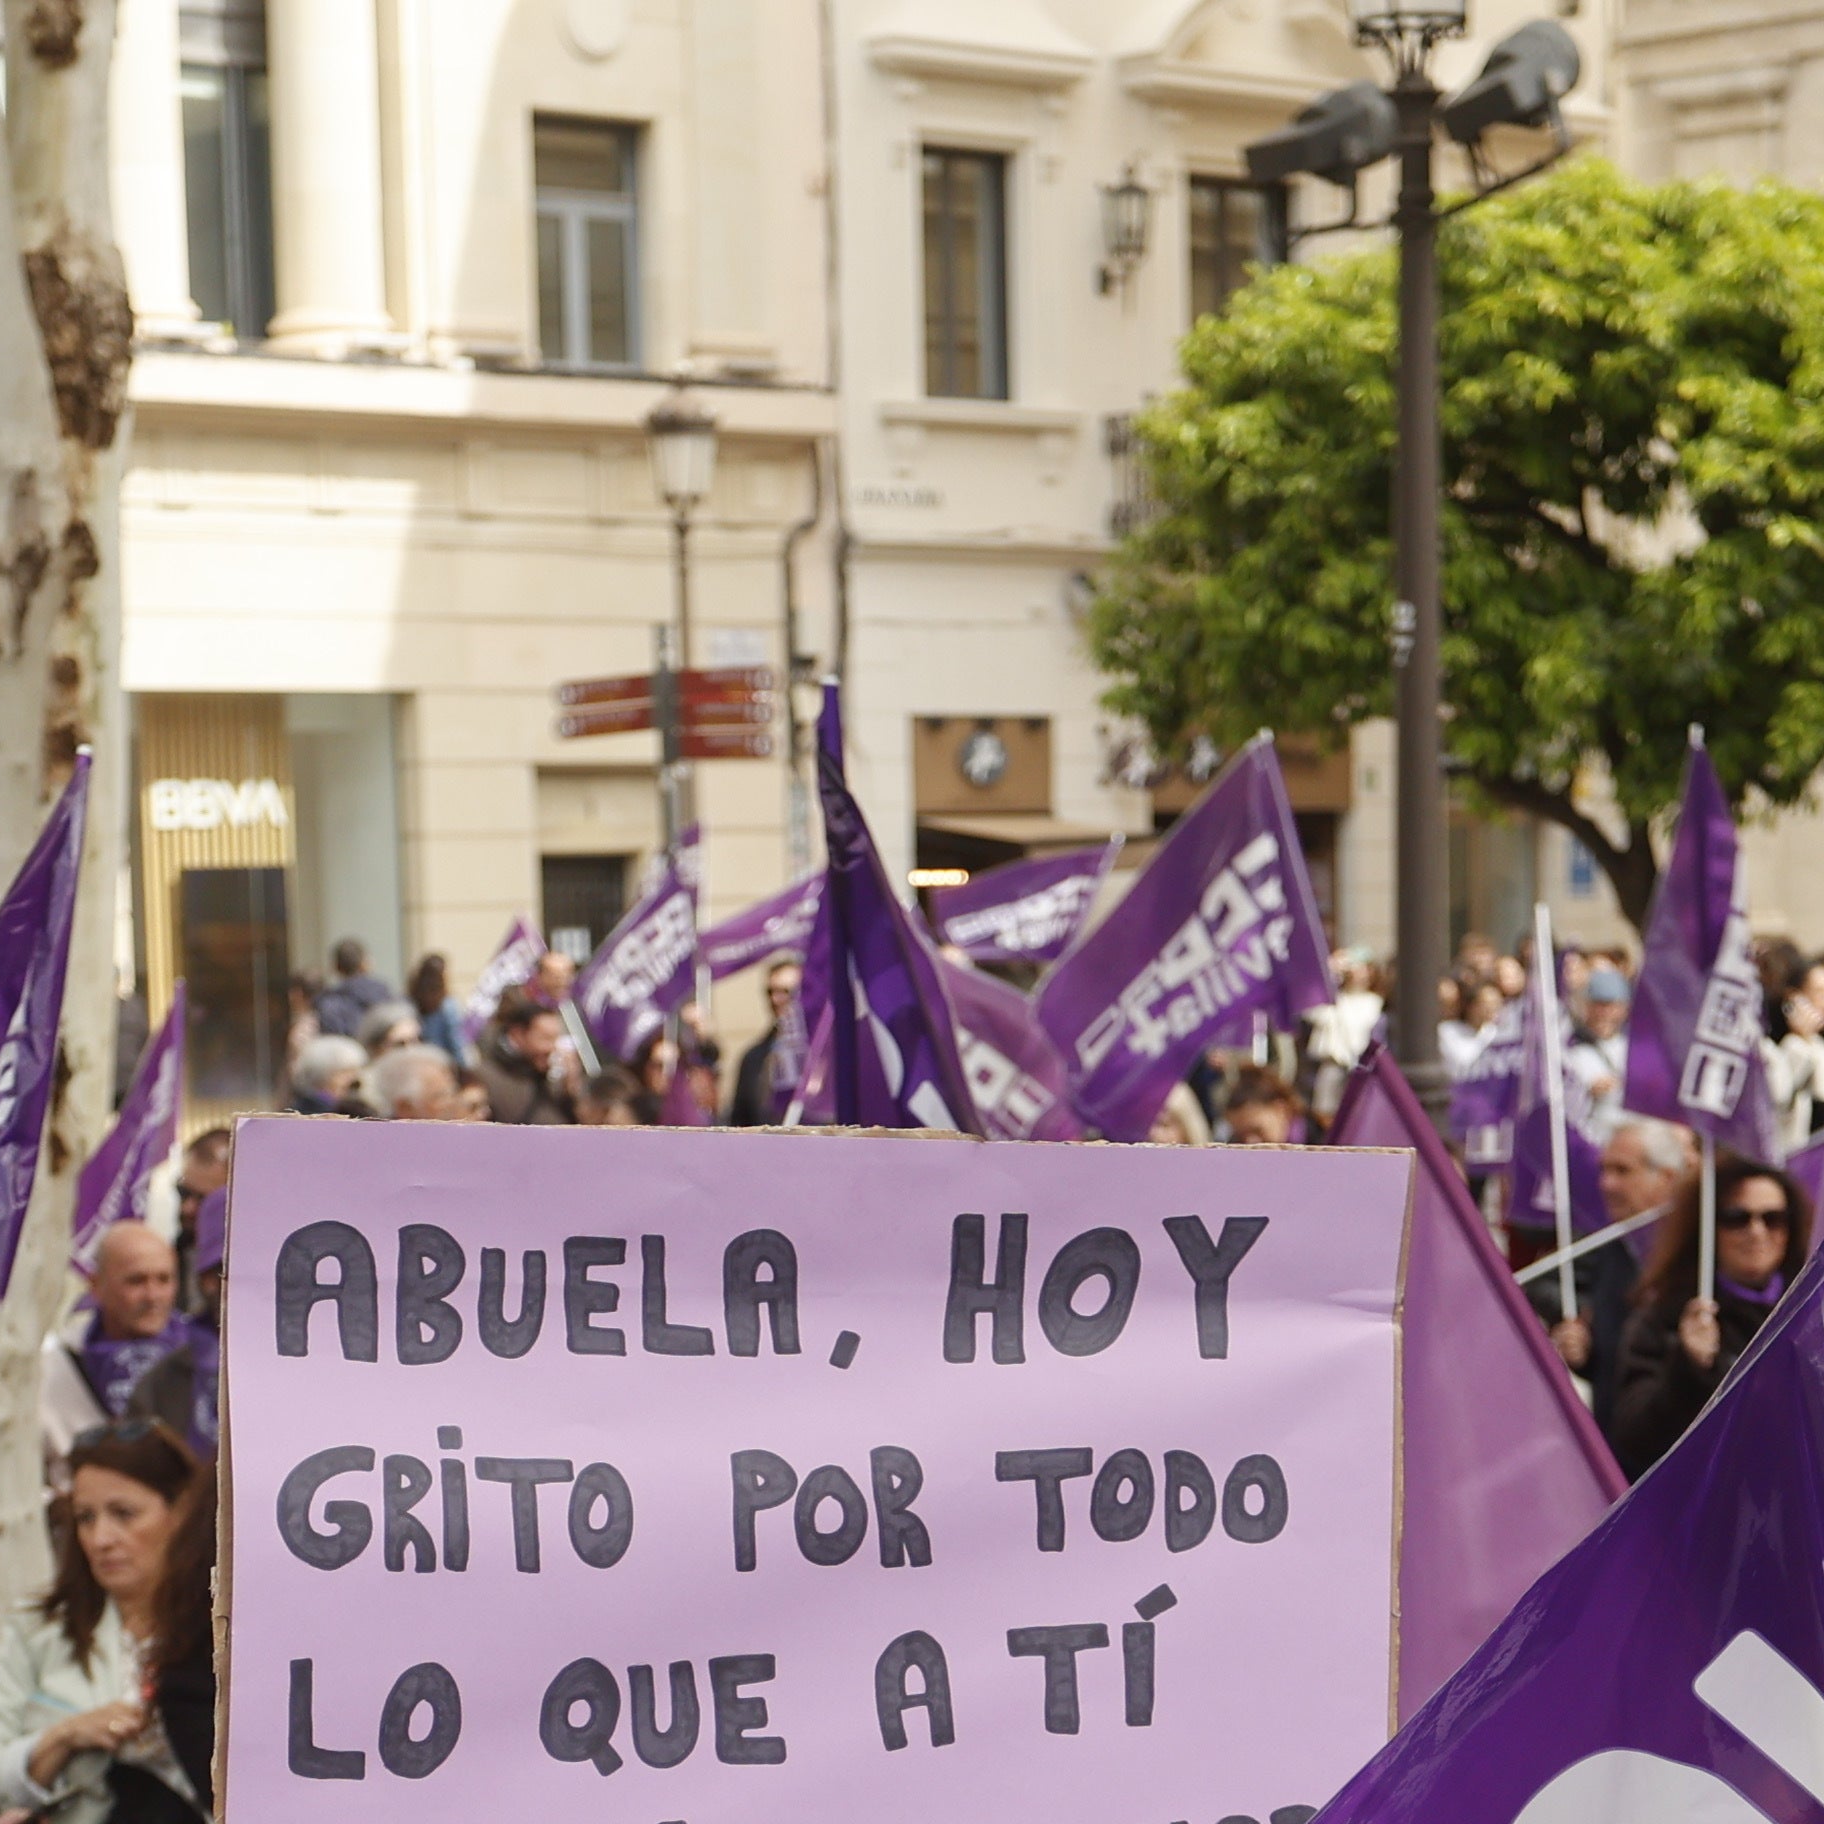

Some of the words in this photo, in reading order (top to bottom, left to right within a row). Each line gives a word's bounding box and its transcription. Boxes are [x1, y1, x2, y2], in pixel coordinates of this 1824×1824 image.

[150, 778, 288, 829] BBVA
[275, 1219, 861, 1369] ABUELA,
[943, 1213, 1269, 1364] HOY
[731, 1445, 932, 1572] POR
[995, 1447, 1288, 1553] TODO
[288, 1657, 461, 1781] LO
[539, 1653, 787, 1776] QUE
[875, 1631, 954, 1751] A
[1006, 1584, 1177, 1736] TÍ
